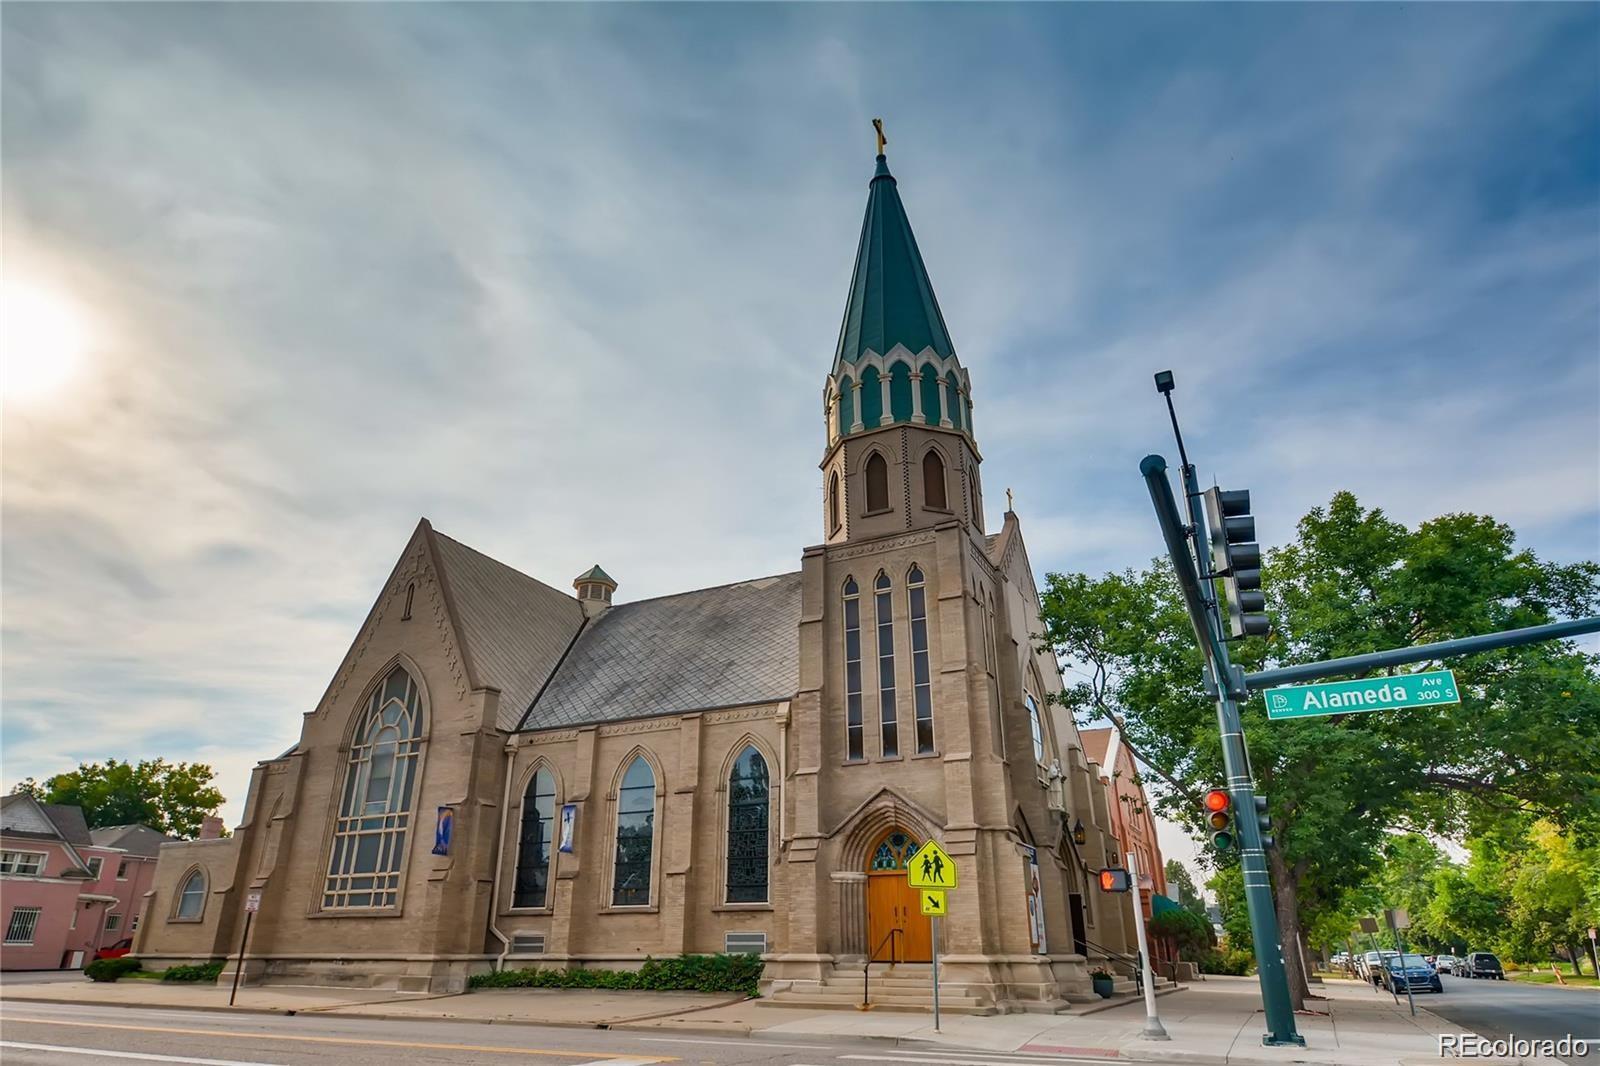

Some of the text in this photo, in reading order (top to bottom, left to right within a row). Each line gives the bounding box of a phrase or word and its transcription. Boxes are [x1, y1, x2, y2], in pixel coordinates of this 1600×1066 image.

[1422, 677, 1442, 687] Ave
[1303, 683, 1408, 711] Alameda
[1417, 688, 1454, 701] 300 S
